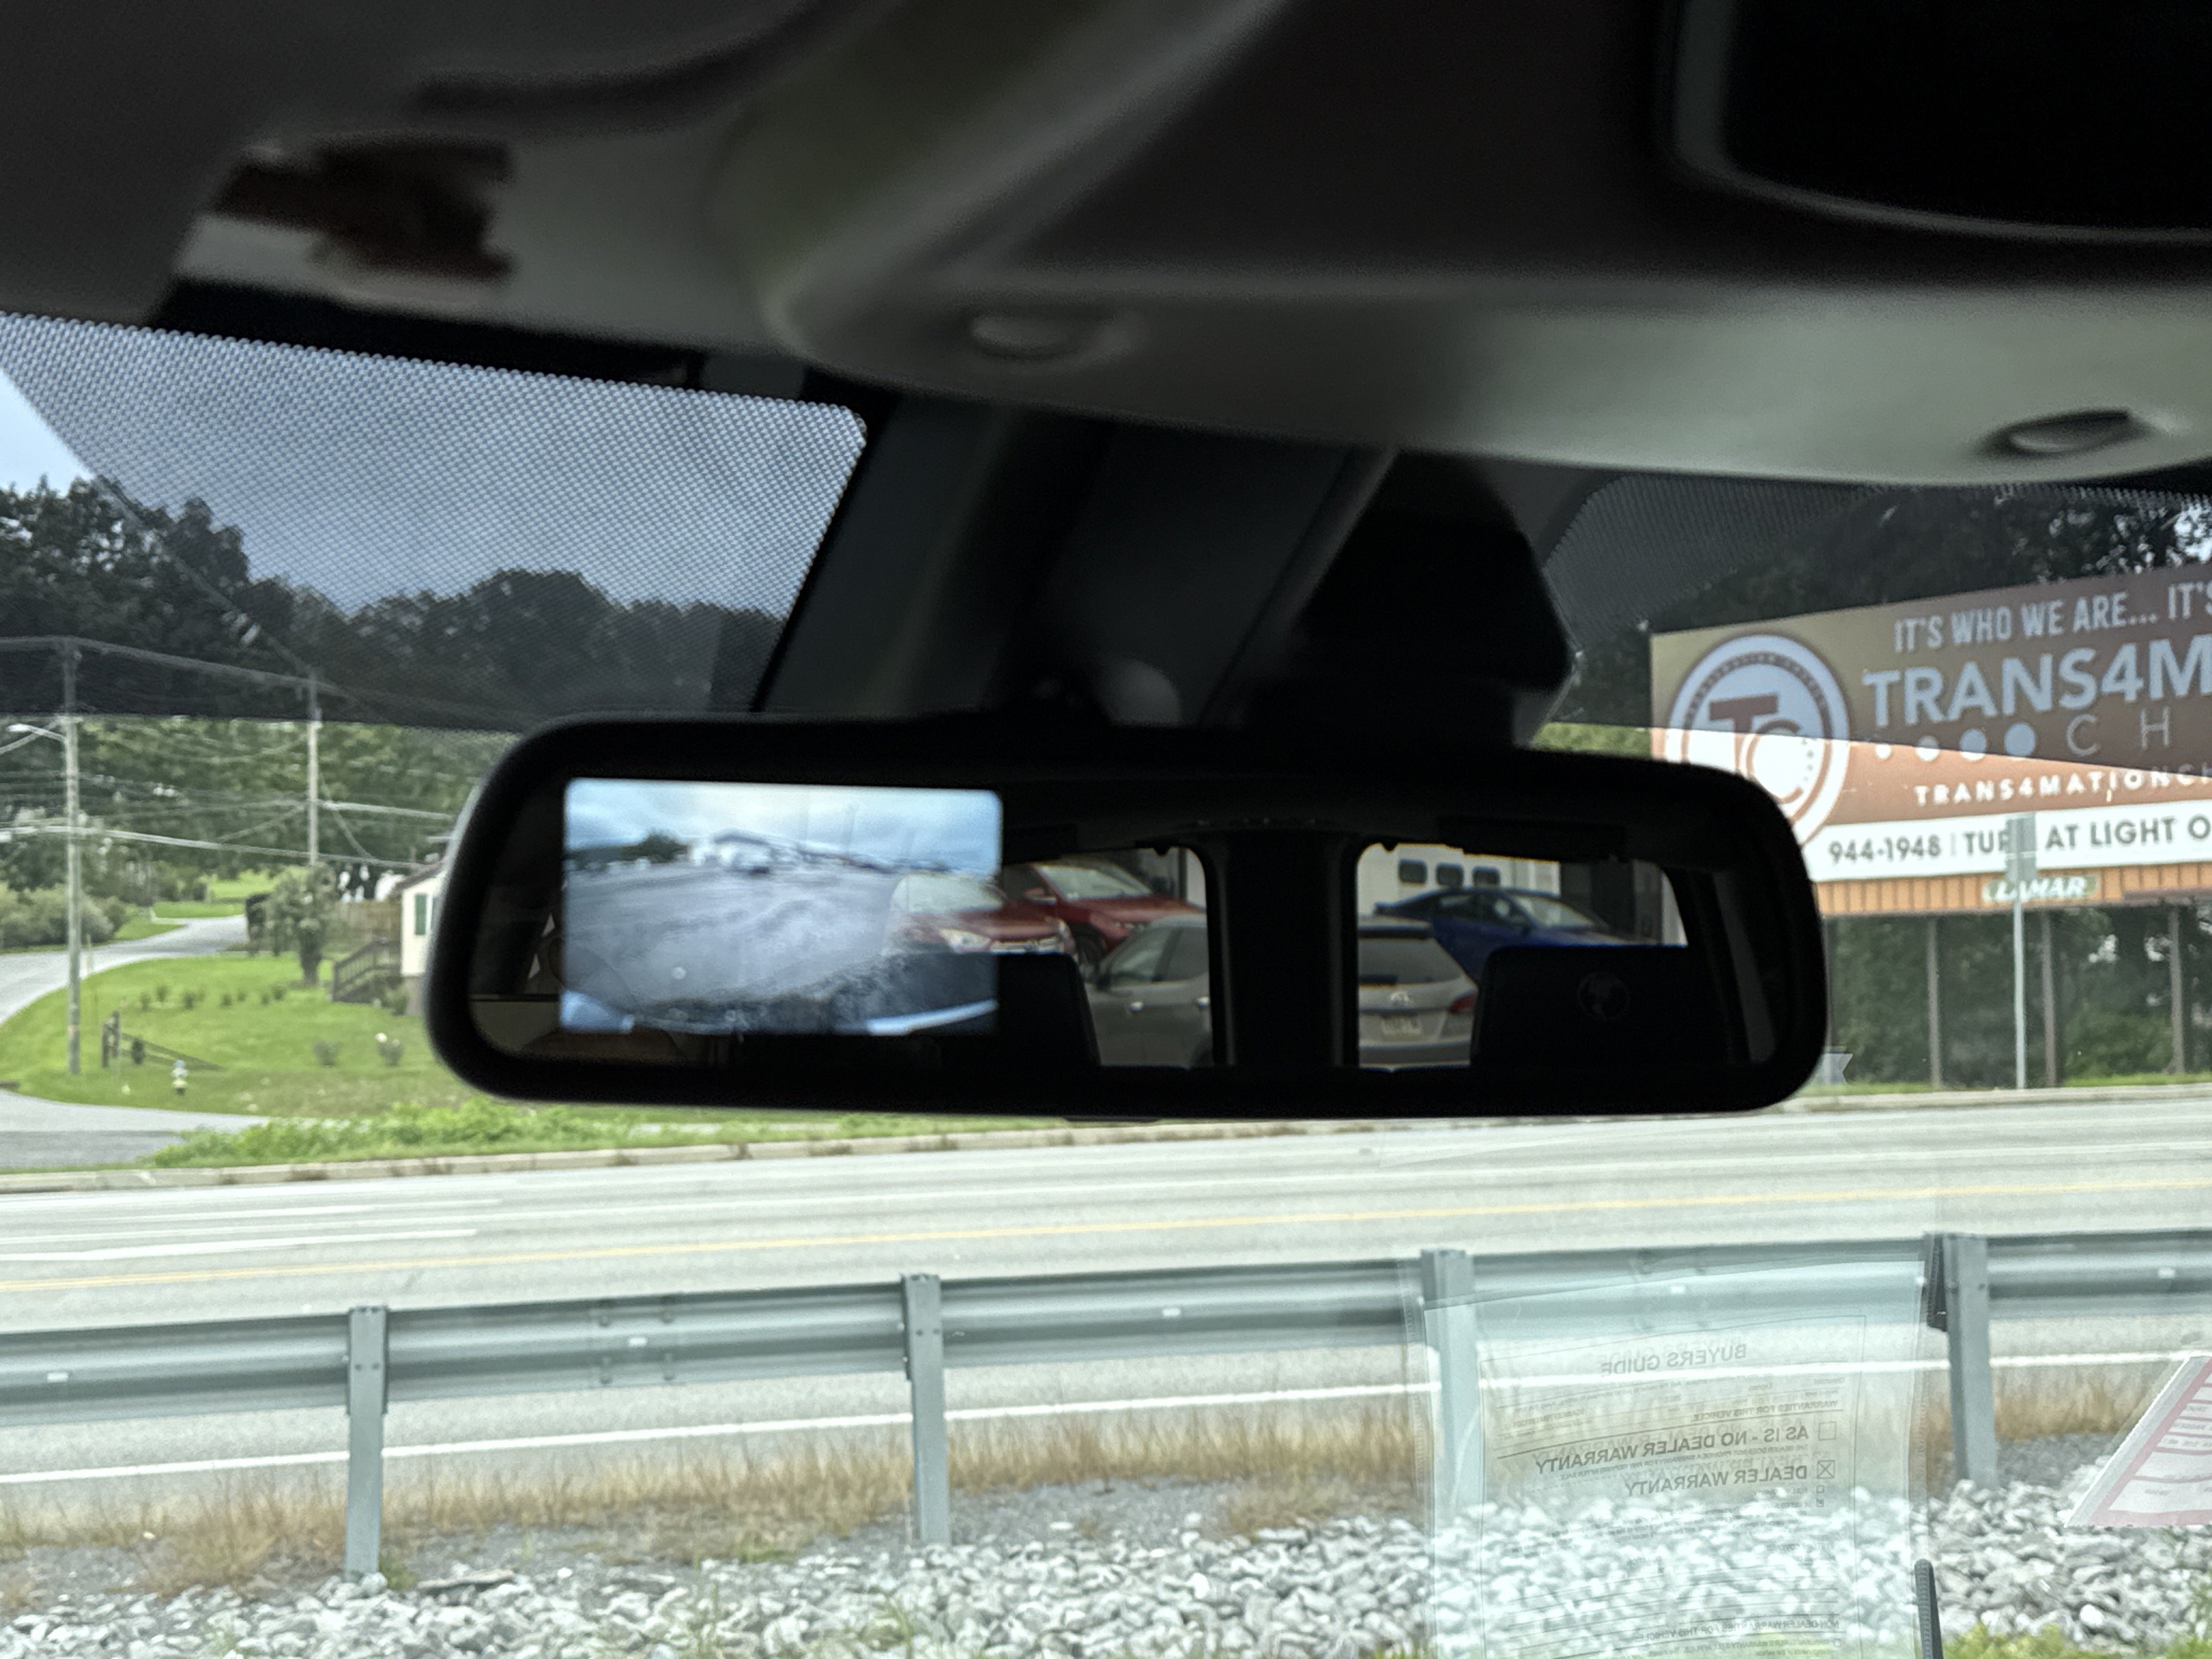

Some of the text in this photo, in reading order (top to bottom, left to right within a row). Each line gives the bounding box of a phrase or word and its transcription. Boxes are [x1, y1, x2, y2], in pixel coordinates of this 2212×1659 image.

[1894, 614, 1944, 653] IT'S
[1950, 605, 2013, 645] WHO
[2021, 599, 2066, 639] WE
[2073, 591, 2159, 634] ARE...
[1863, 633, 2212, 726] TRANS4M
[1829, 833, 1942, 864] 944-1948
[2045, 823, 2080, 849] AT
[2090, 816, 2182, 847] LIGHT
